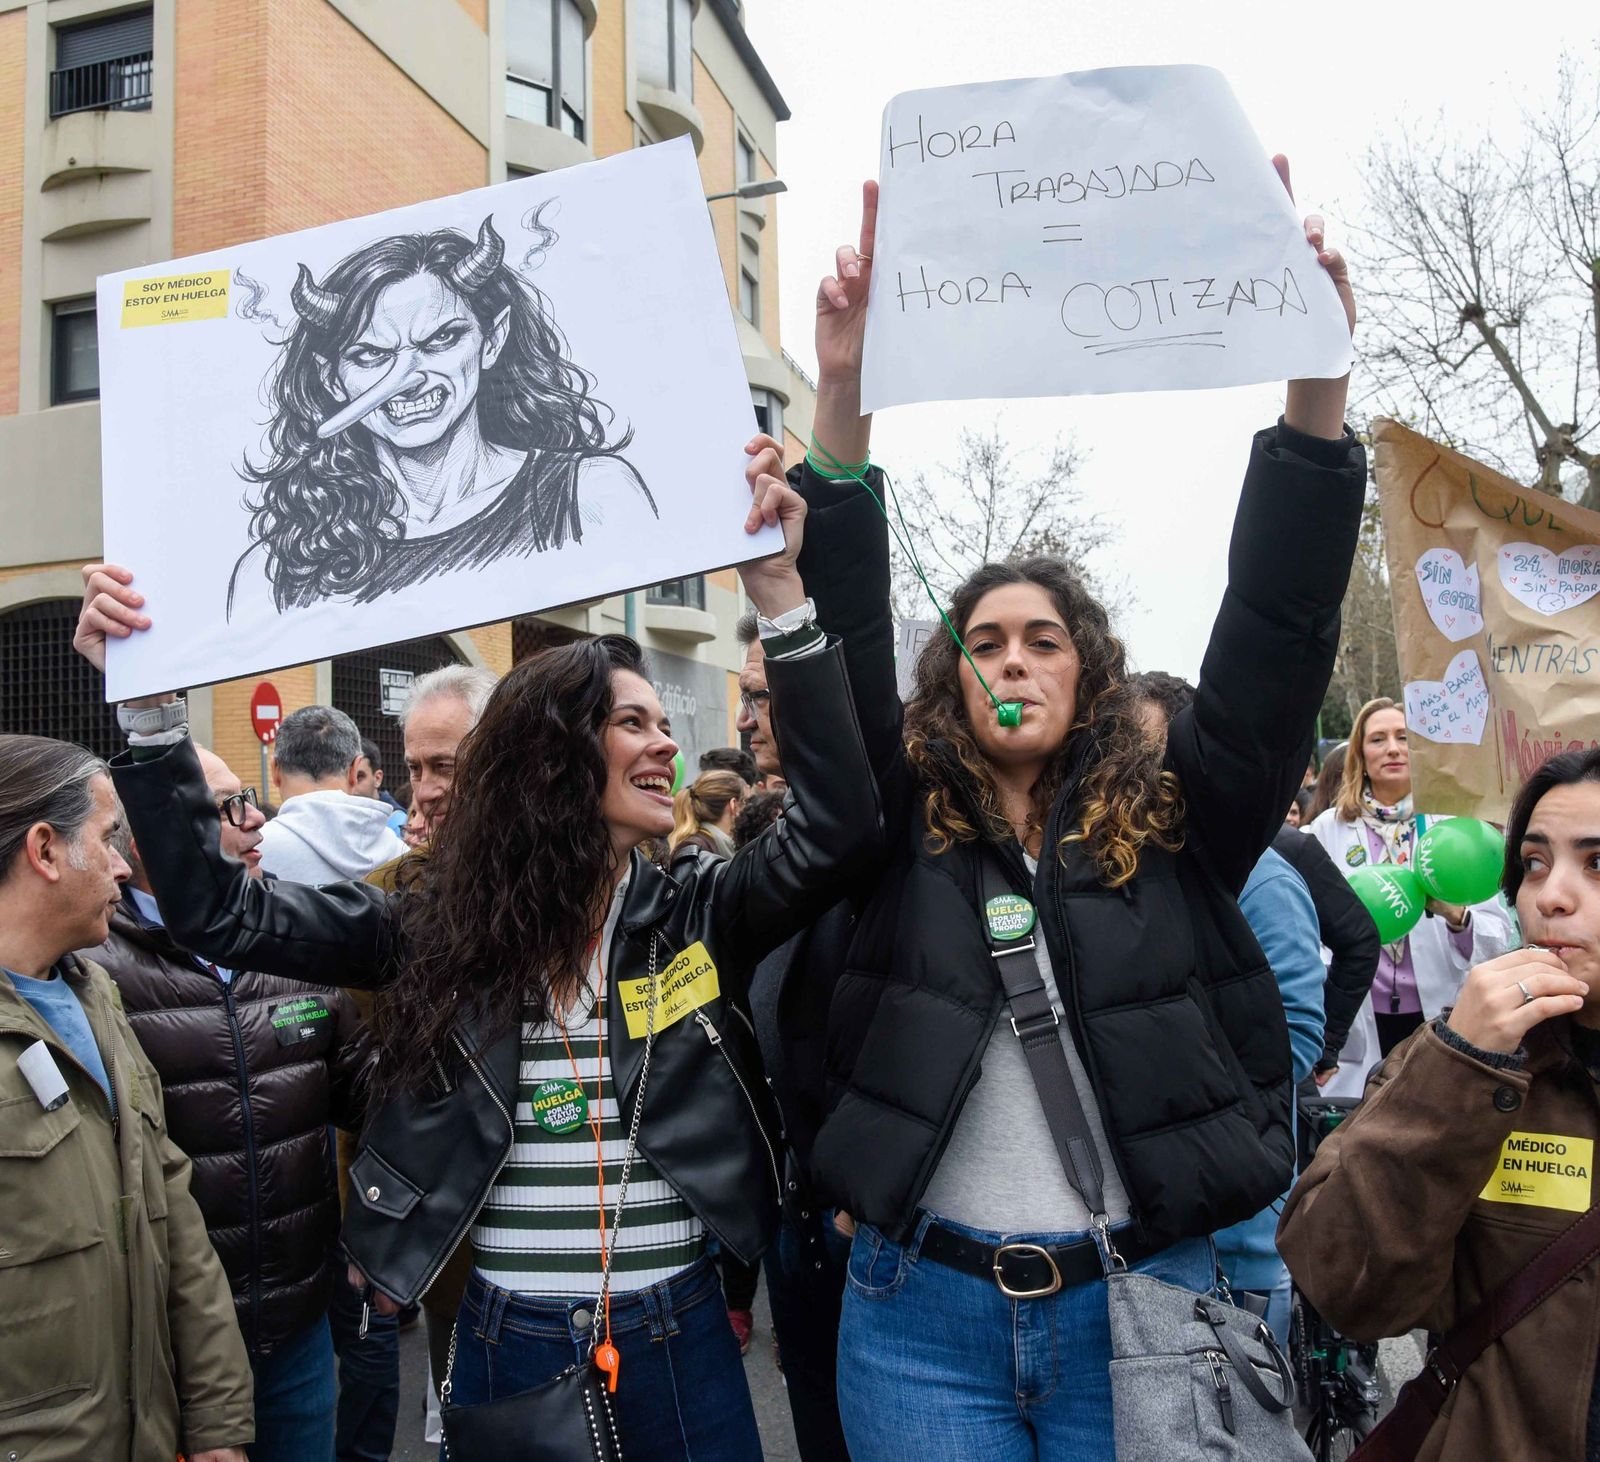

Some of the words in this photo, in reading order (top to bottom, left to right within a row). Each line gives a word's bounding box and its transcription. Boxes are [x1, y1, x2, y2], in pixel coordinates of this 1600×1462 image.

[889, 114, 1016, 168] HORA
[972, 158, 1215, 208] TRABAJADA
[143, 283, 165, 293] SOY
[167, 276, 212, 290] MÉDICO
[897, 265, 1032, 311] HORA
[125, 296, 161, 307] ESTOY
[163, 294, 179, 303] EN
[181, 288, 227, 301] HUELGA
[1558, 580, 1598, 593] PARAR
[1431, 702, 1449, 717] QUE
[1427, 720, 1441, 734] EN
[1448, 711, 1461, 722] EL
[992, 915, 1009, 923] POR
[1010, 913, 1022, 921] UN
[994, 923, 1023, 932] PROPIO
[672, 962, 712, 992] HUELGA
[274, 1017, 295, 1028] ESTOY
[295, 1014, 306, 1023] EN
[306, 1009, 329, 1021] HUELGA
[278, 1005, 292, 1015] SOY
[533, 1088, 583, 1112] HUELGA
[547, 1106, 562, 1116] POR
[563, 1102, 576, 1111] UN
[543, 1106, 582, 1124] ESTATUTO
[551, 1113, 579, 1128] PROPIO
[1507, 1138, 1567, 1155] MÉDICO
[1503, 1158, 1522, 1171] EN
[1525, 1159, 1588, 1179] HUELGA
